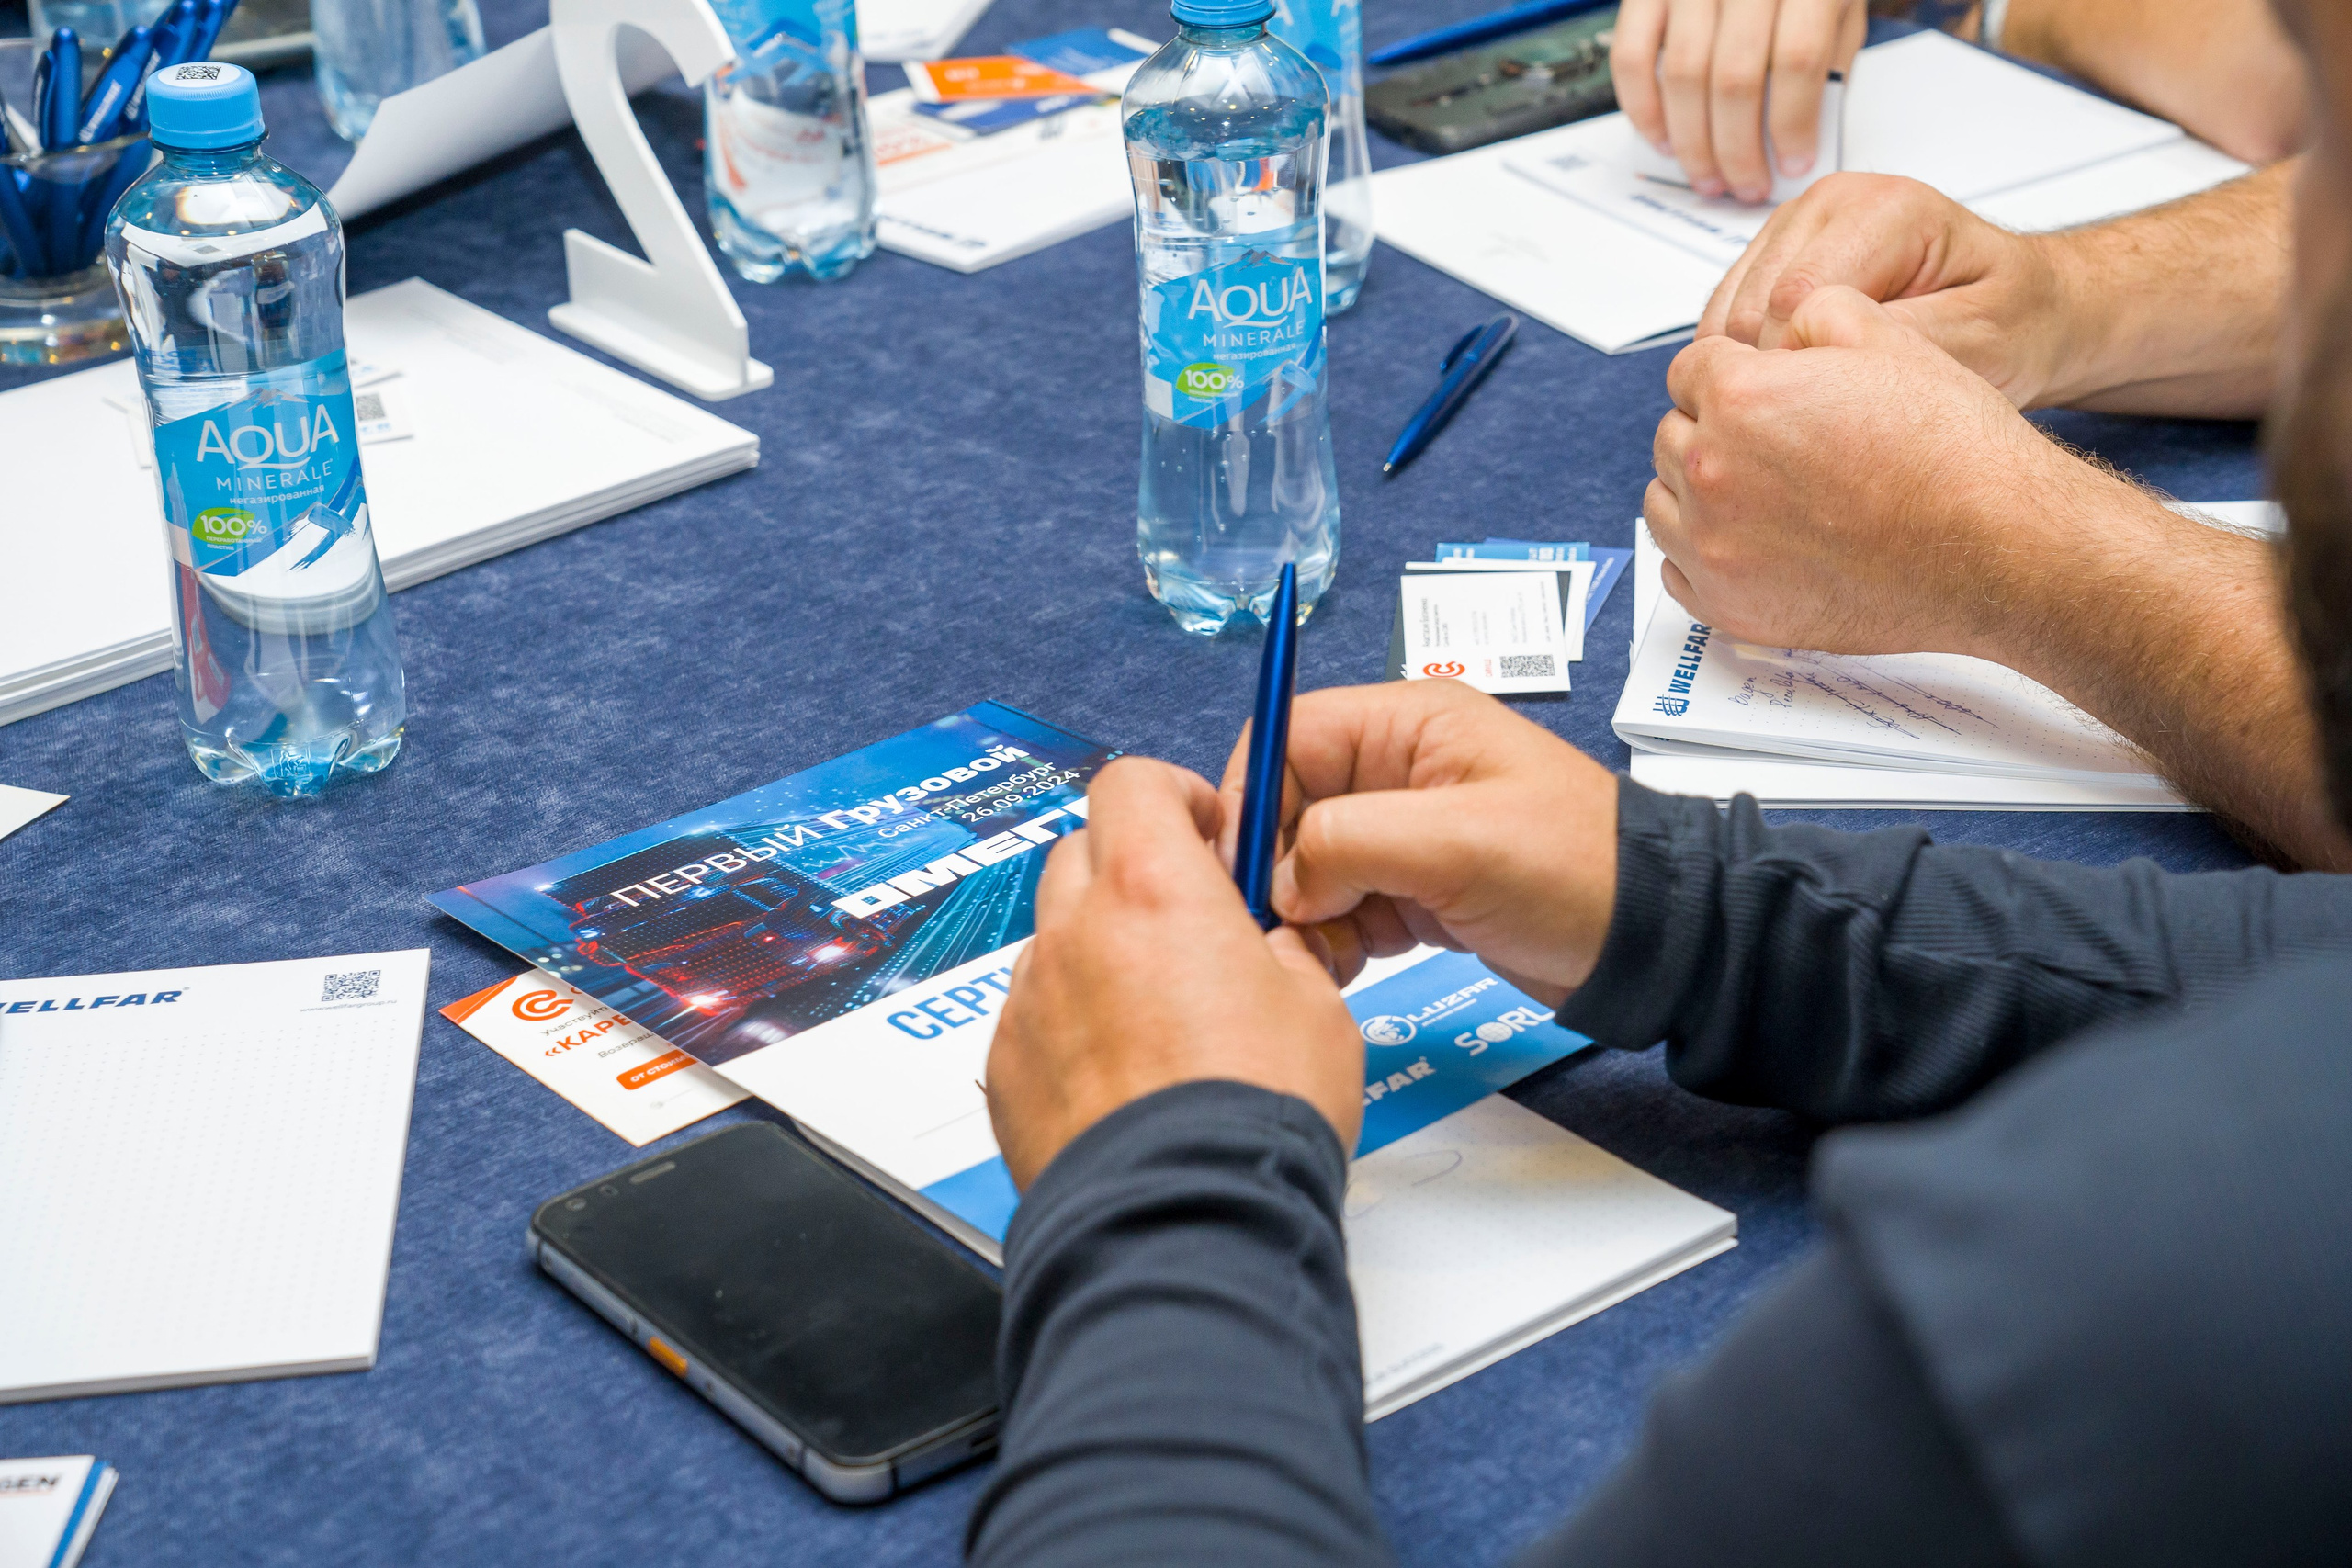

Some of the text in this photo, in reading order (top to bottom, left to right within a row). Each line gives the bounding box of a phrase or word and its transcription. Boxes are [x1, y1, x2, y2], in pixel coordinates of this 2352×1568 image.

[1188, 266, 1313, 328] AQUA
[1204, 321, 1304, 347] MINERALE
[1213, 343, 1296, 361] негазированная
[1185, 369, 1244, 390] 100%
[196, 403, 340, 471] AQUA
[216, 460, 332, 491] MINERALE
[229, 484, 325, 506] негазированная
[200, 514, 267, 536] 100%
[1668, 623, 1713, 694] WELLFAR
[877, 761, 1056, 839] Санкт-Петербург
[961, 770, 1080, 823] 26.09.2024
[609, 744, 1030, 908] ПЕРВЫЙ Грузовой
[0, 990, 183, 1015] ELLFAR
[886, 966, 1012, 1040] СЕРТ
[1406, 977, 1498, 1022] LUZAR
[1454, 1006, 1555, 1057] SORL
